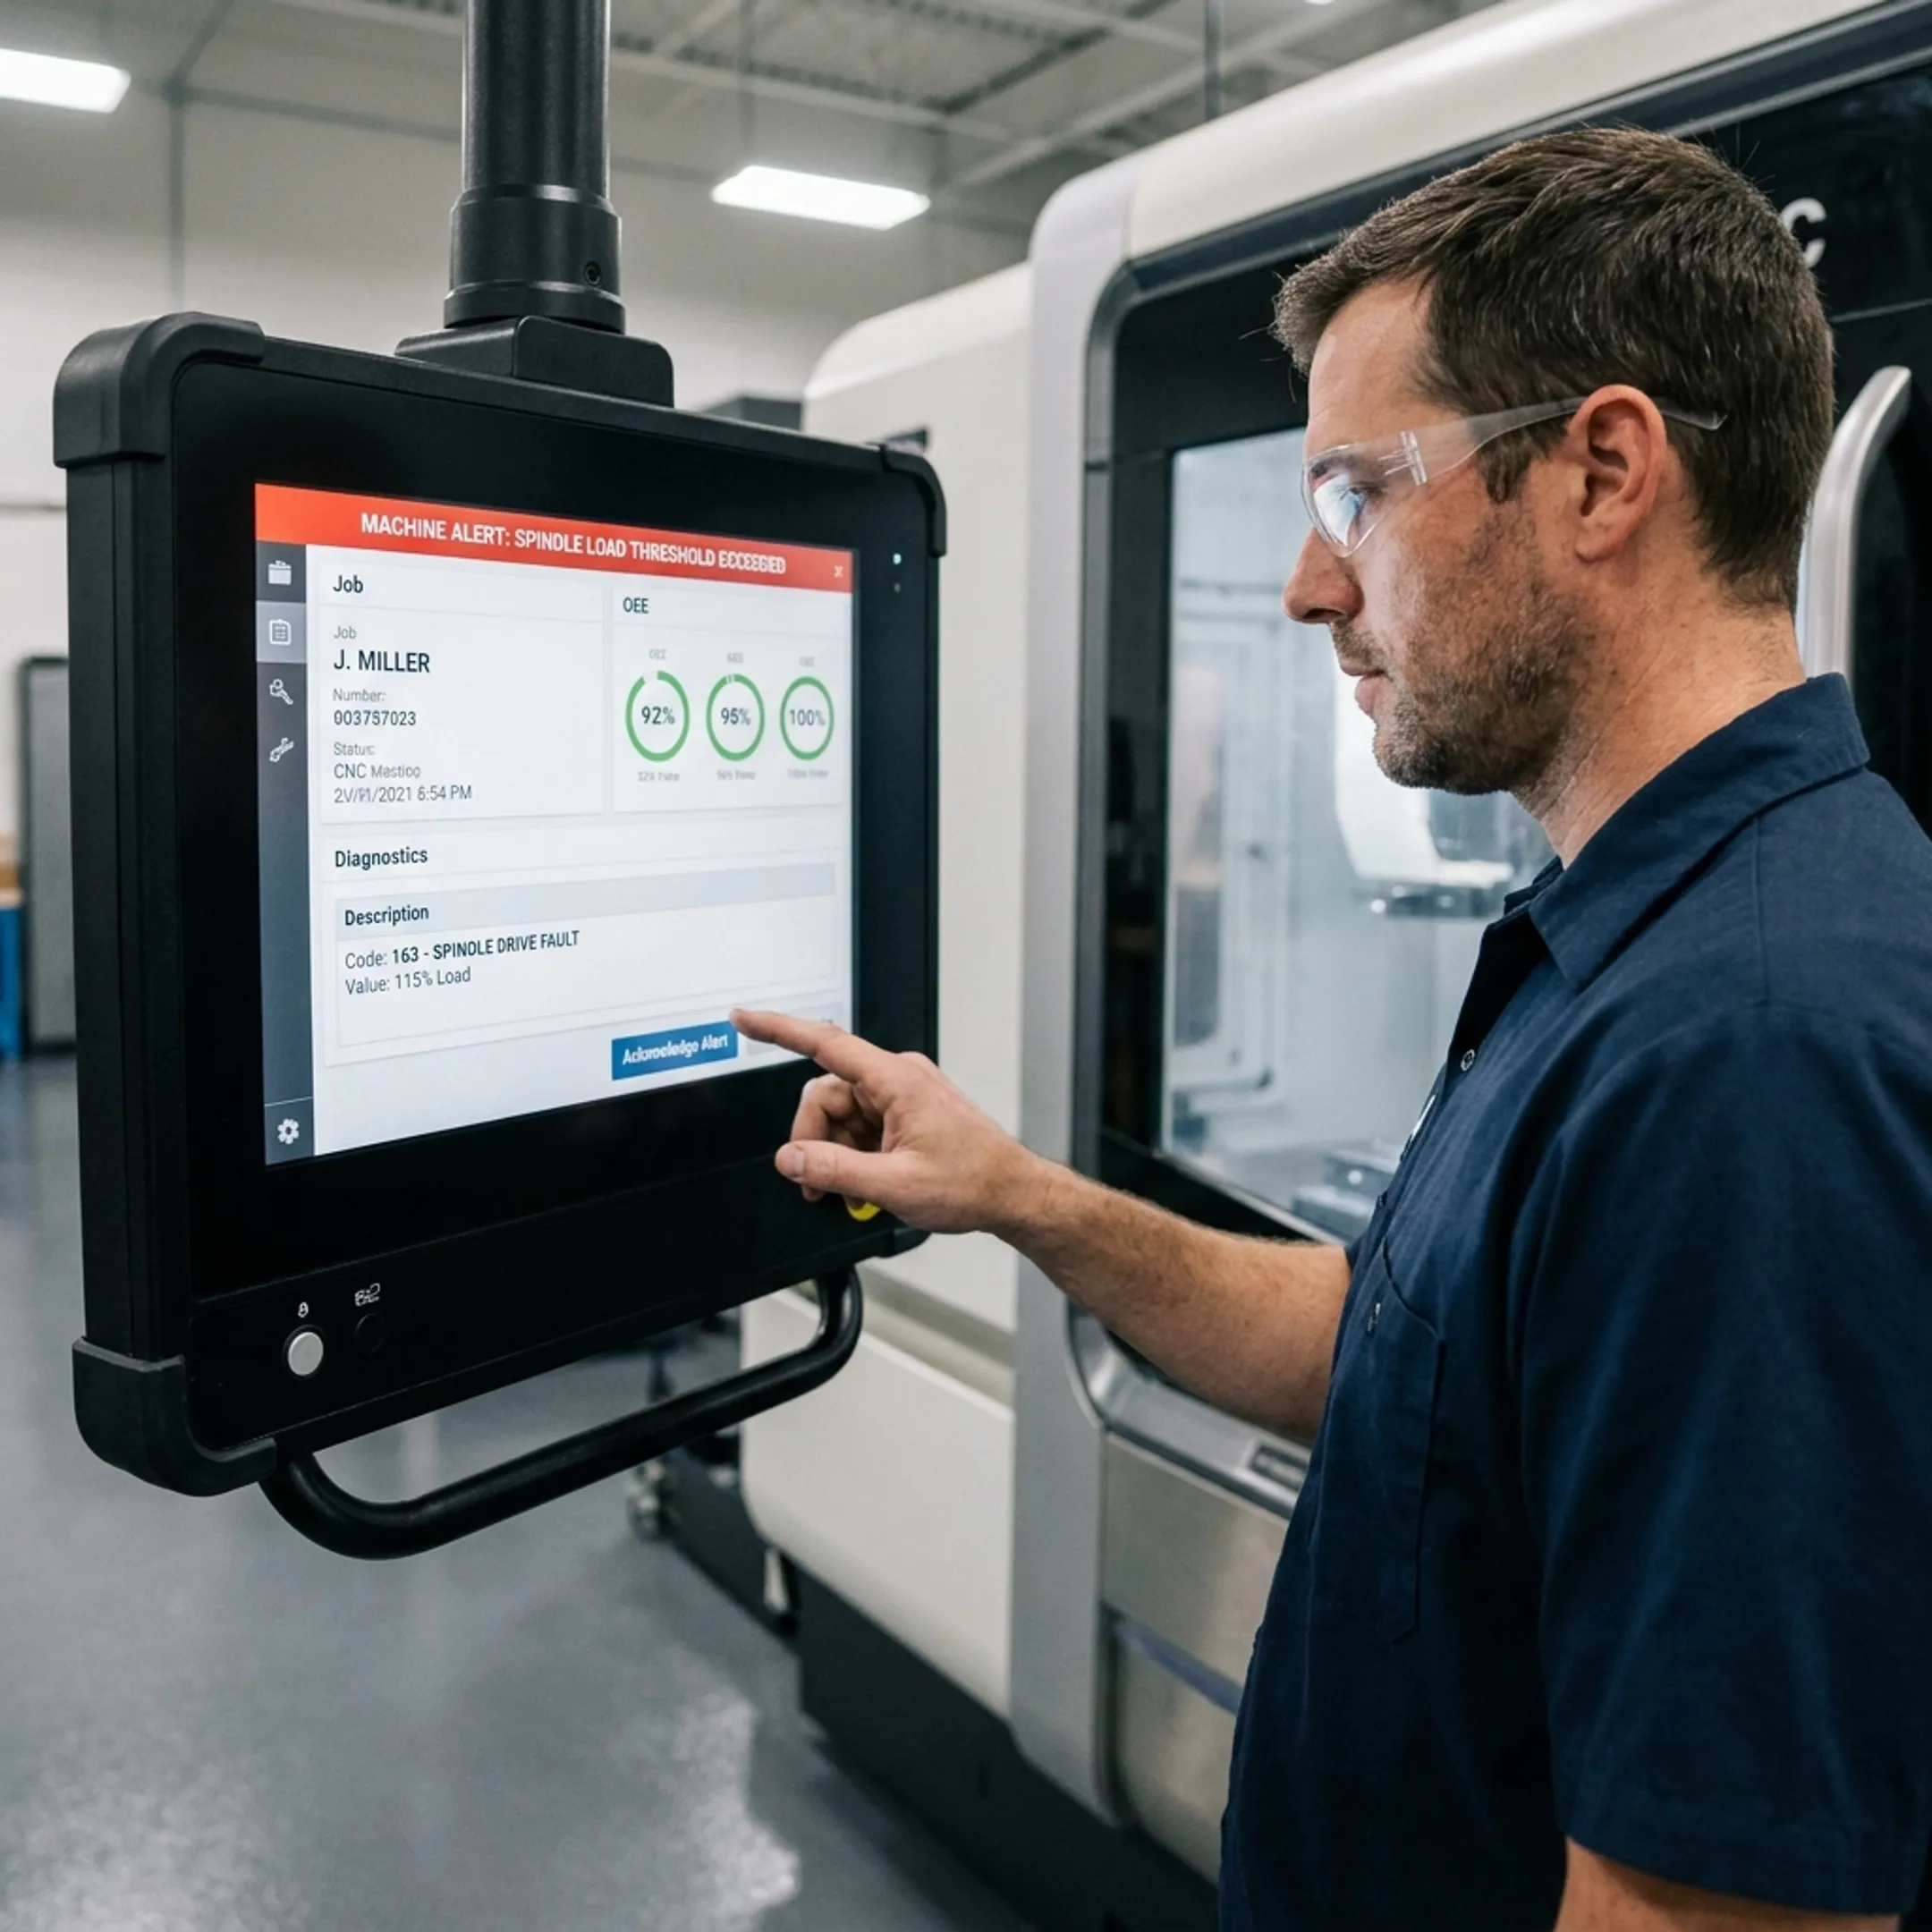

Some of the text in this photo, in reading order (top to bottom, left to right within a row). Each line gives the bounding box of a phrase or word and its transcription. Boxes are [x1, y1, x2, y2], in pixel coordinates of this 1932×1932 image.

[361, 513, 446, 539] MACHINE
[451, 522, 511, 547] ALERT:
[514, 529, 583, 554] SPINDLE
[587, 536, 627, 558] LOAD
[629, 540, 716, 567] THRESHOLD
[333, 574, 364, 594] Job
[623, 597, 648, 614] OEE
[334, 626, 357, 640] Job
[334, 648, 430, 673] J. MILLER
[333, 689, 386, 702] Number:
[641, 706, 675, 725] 92%
[721, 708, 750, 726] 95%
[790, 709, 826, 726] 100%
[334, 763, 367, 778] CNC
[418, 785, 446, 801] 6:54
[451, 784, 472, 800] PM
[335, 846, 428, 870] Diagnostics
[344, 904, 429, 926] Description
[345, 952, 387, 969] Code:
[392, 946, 419, 963] 163
[433, 938, 494, 960] SPINDLE
[496, 934, 537, 953] DRIVE
[540, 930, 580, 950] FAULT
[345, 966, 471, 995] Value: 115% Load
